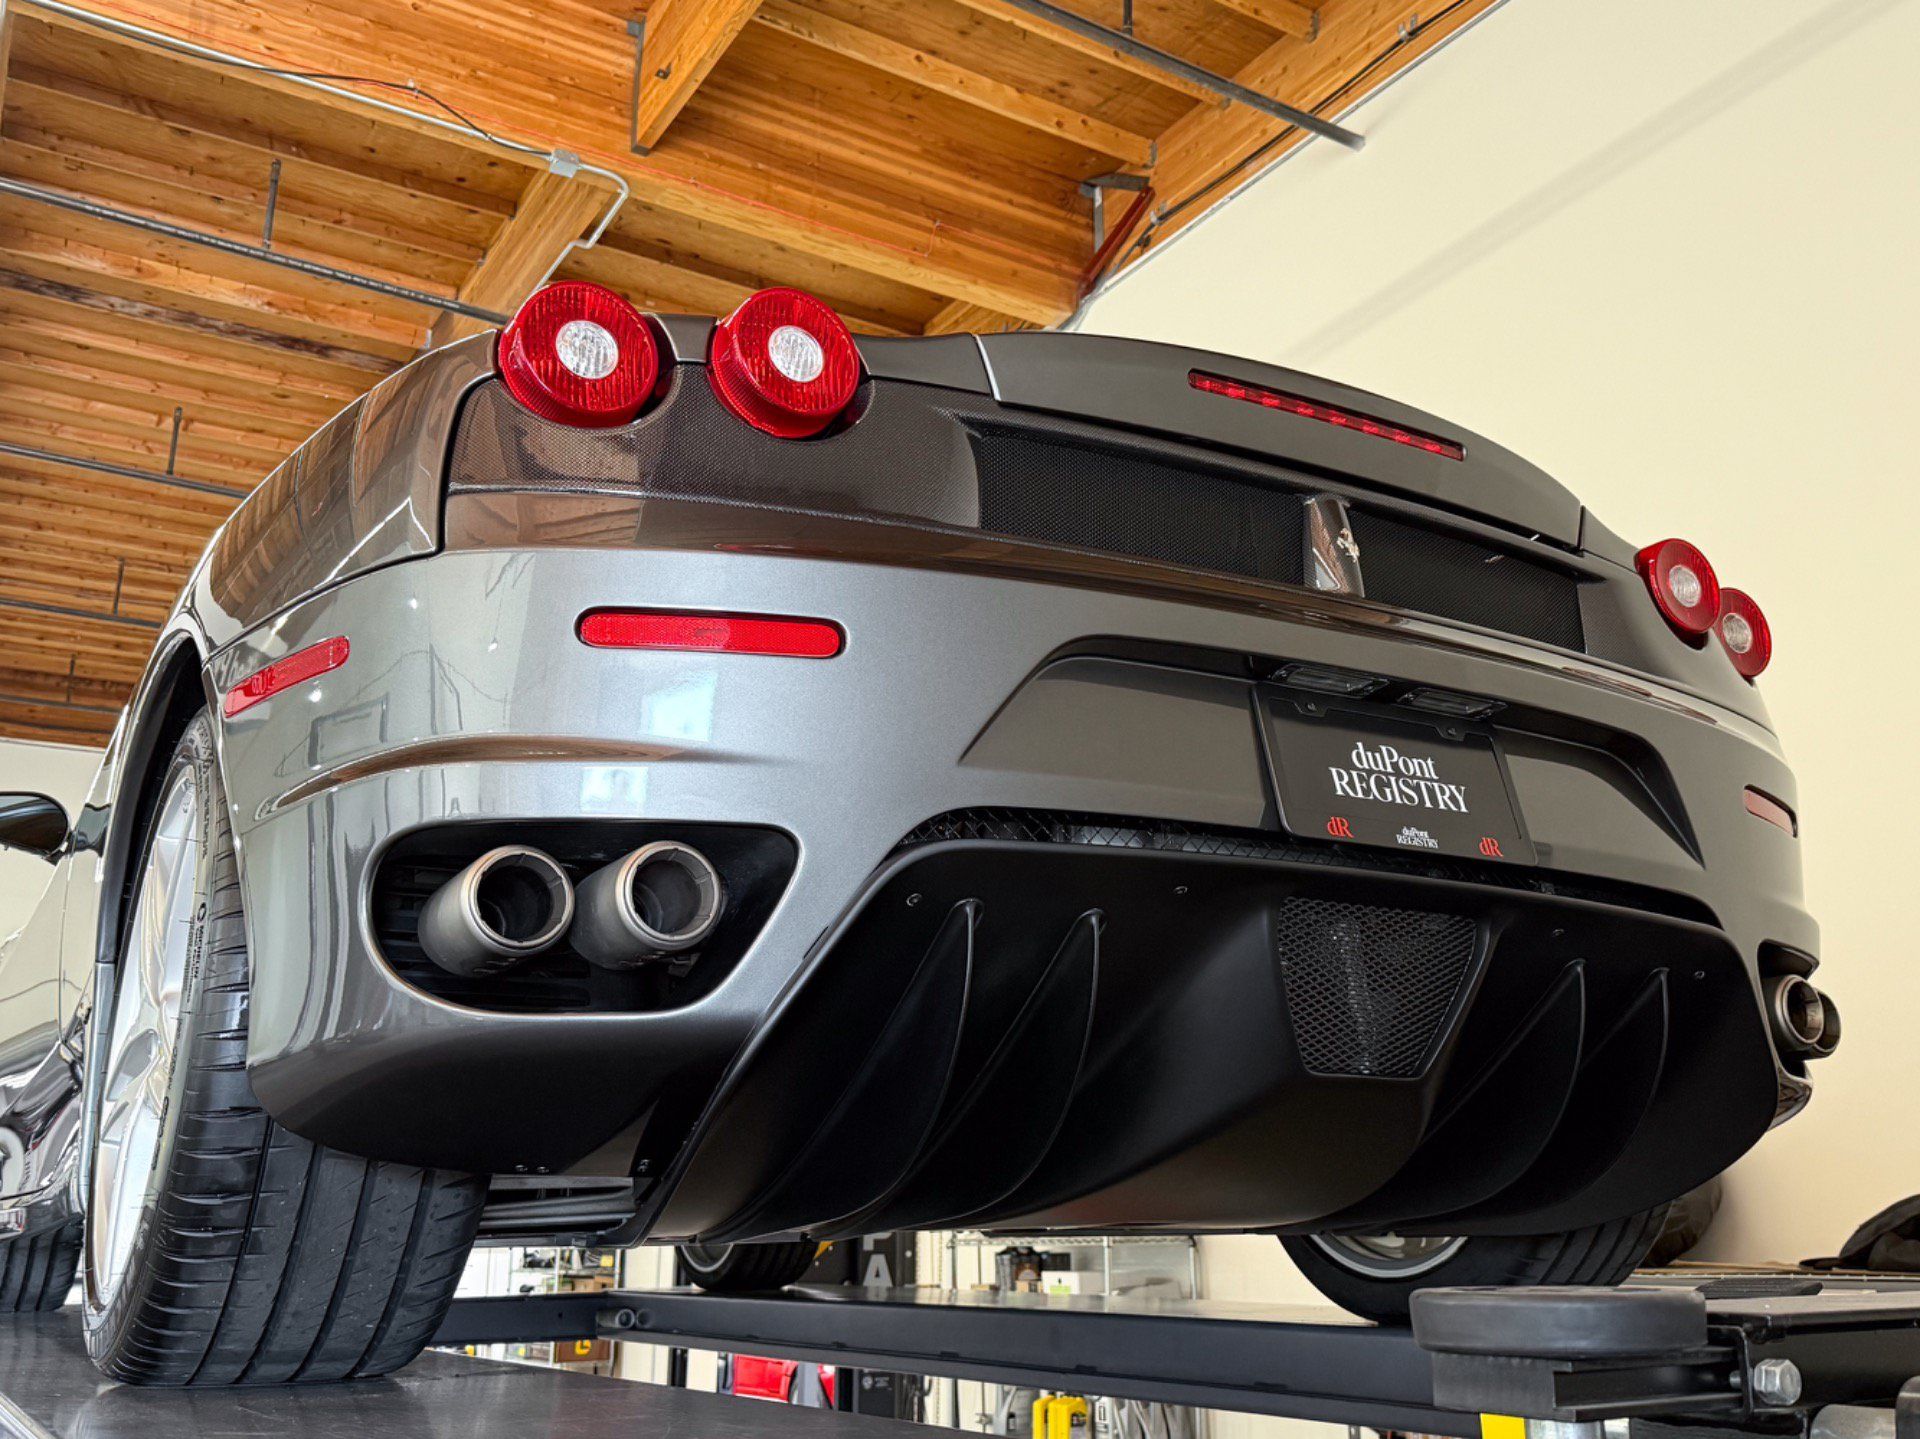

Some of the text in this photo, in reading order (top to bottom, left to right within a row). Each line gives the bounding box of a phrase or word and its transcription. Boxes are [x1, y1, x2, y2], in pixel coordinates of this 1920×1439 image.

[1351, 742, 1439, 780] duPont
[1328, 766, 1469, 813] REGISTRY
[1396, 834, 1439, 849] REGISTRY
